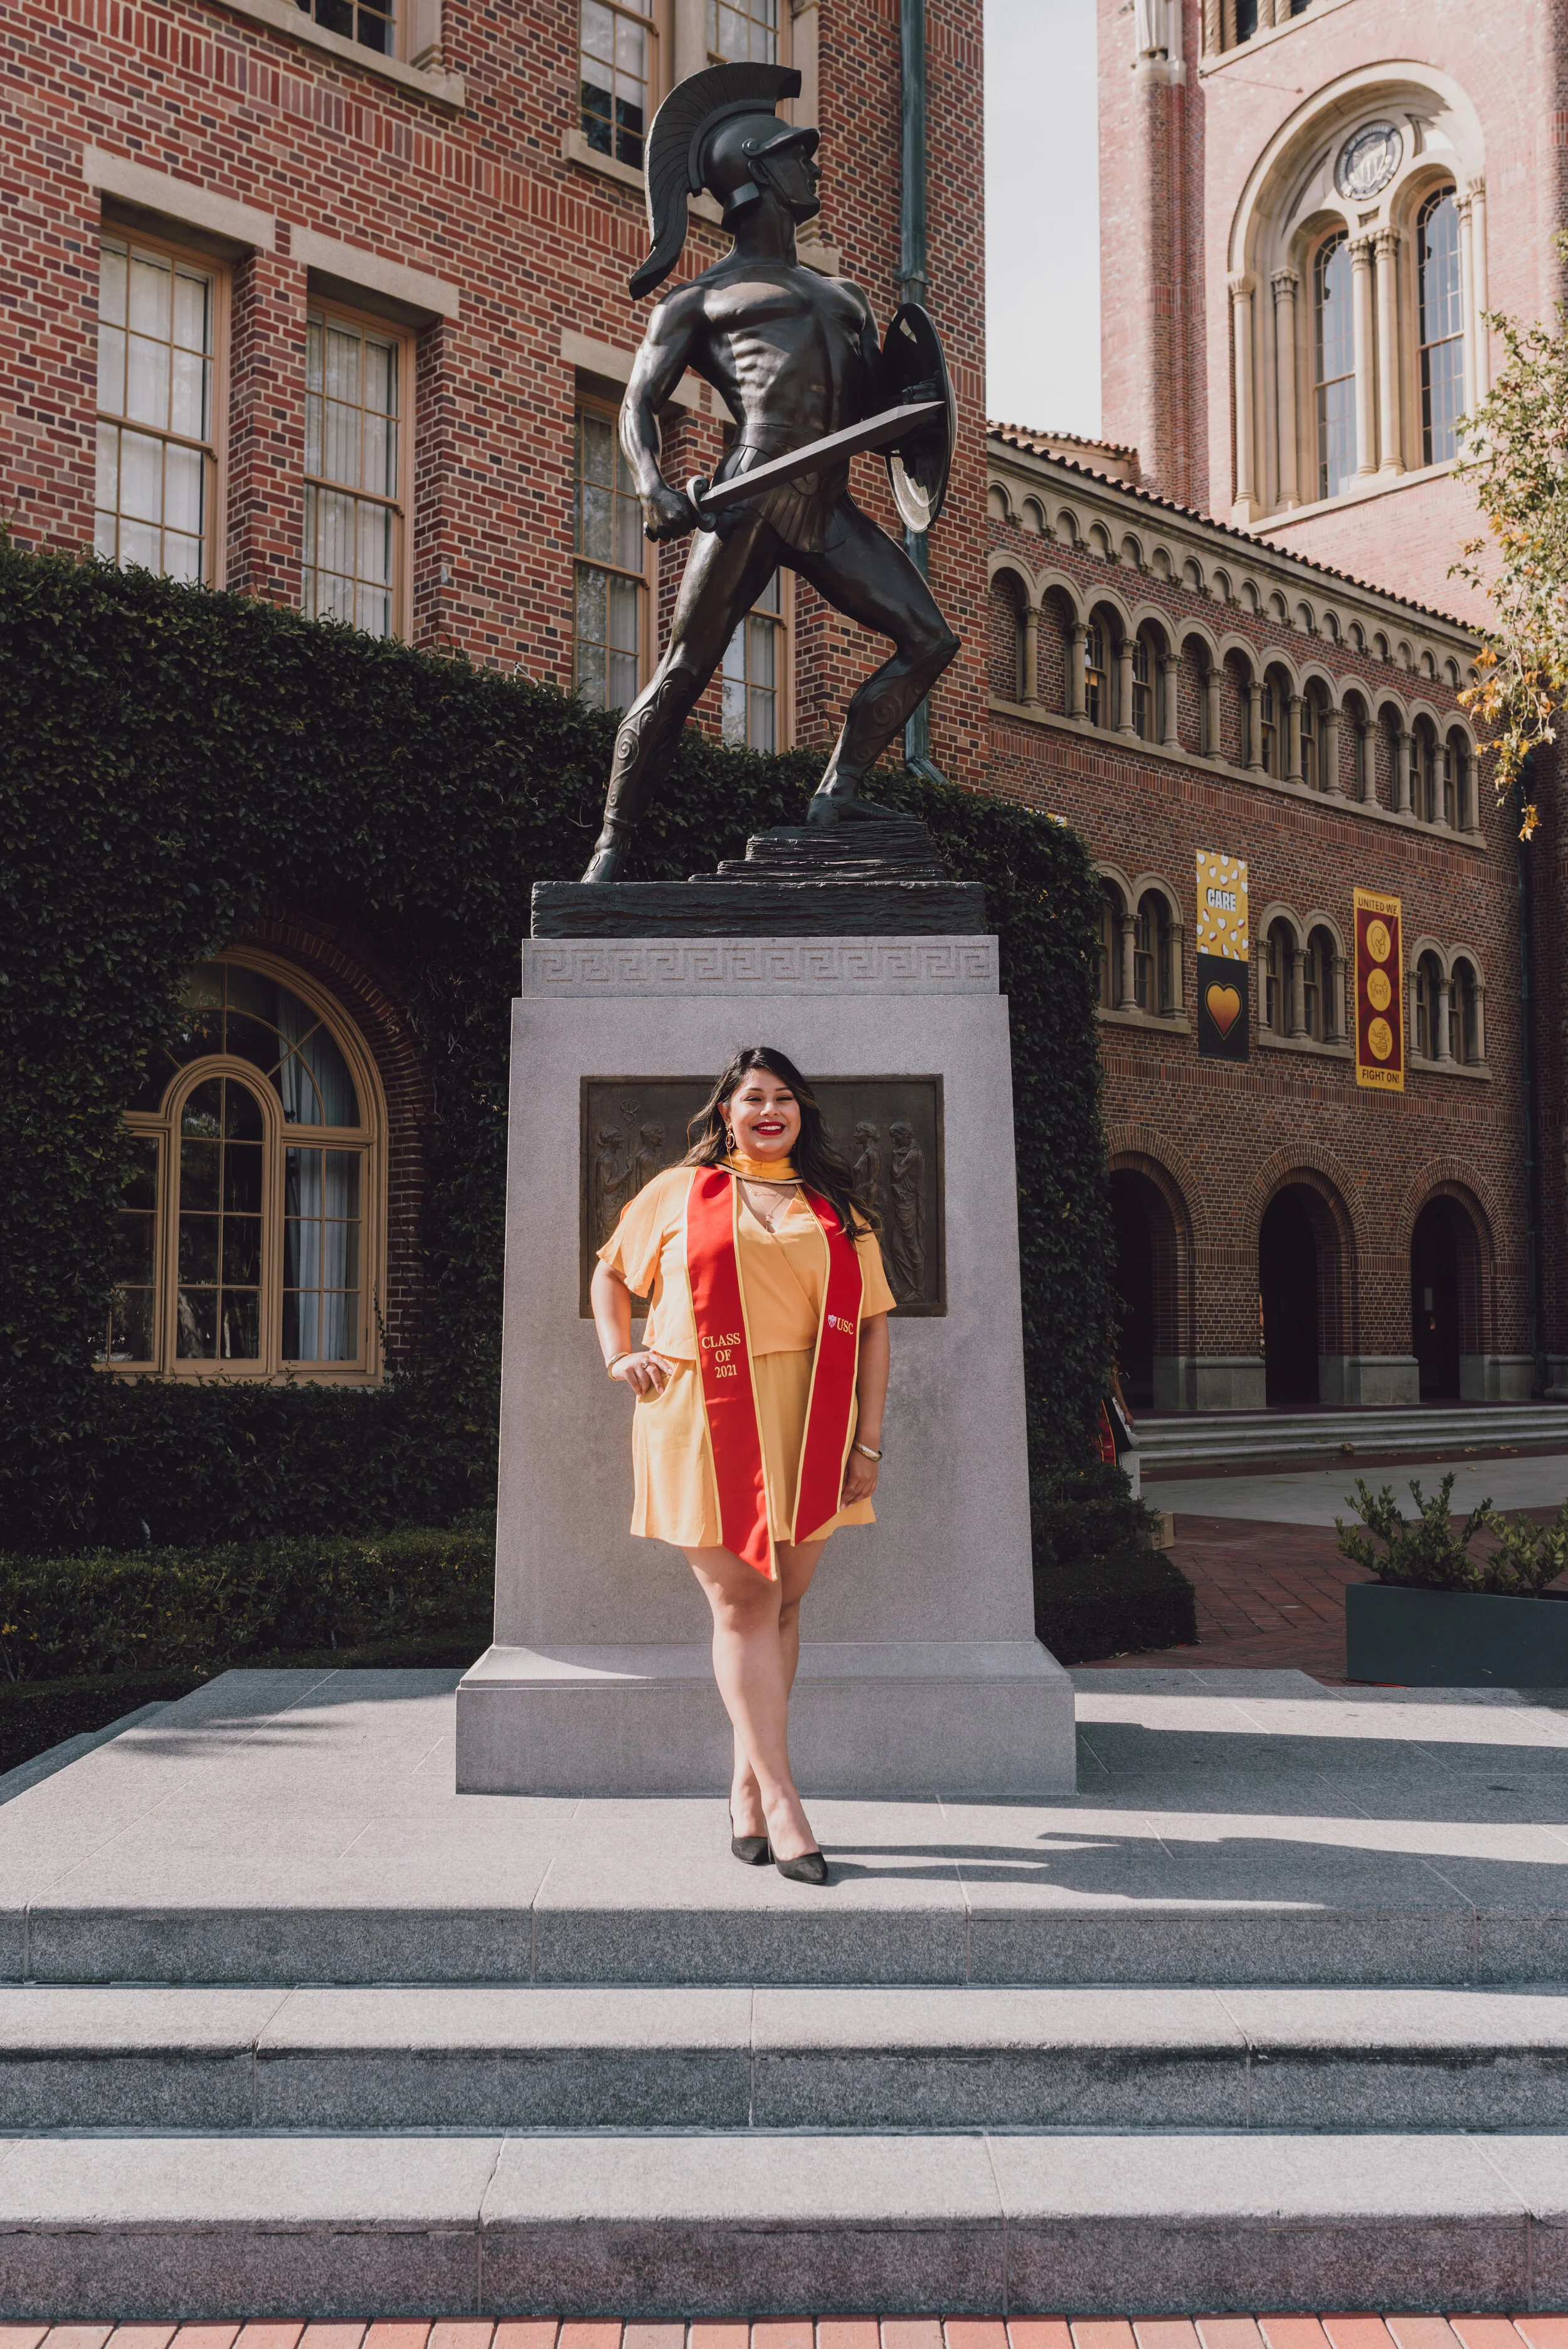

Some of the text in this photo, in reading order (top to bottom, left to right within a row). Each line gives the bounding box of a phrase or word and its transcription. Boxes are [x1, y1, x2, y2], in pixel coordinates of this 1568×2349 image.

[1206, 886, 1236, 913] CARE
[1358, 896, 1397, 915] UNITED WE
[1362, 1069, 1399, 1084] FIGHT ON!
[837, 1317, 854, 1335] USC
[701, 1332, 741, 1349] CLASS
[715, 1349, 732, 1362] OF
[714, 1364, 738, 1378] 2021
